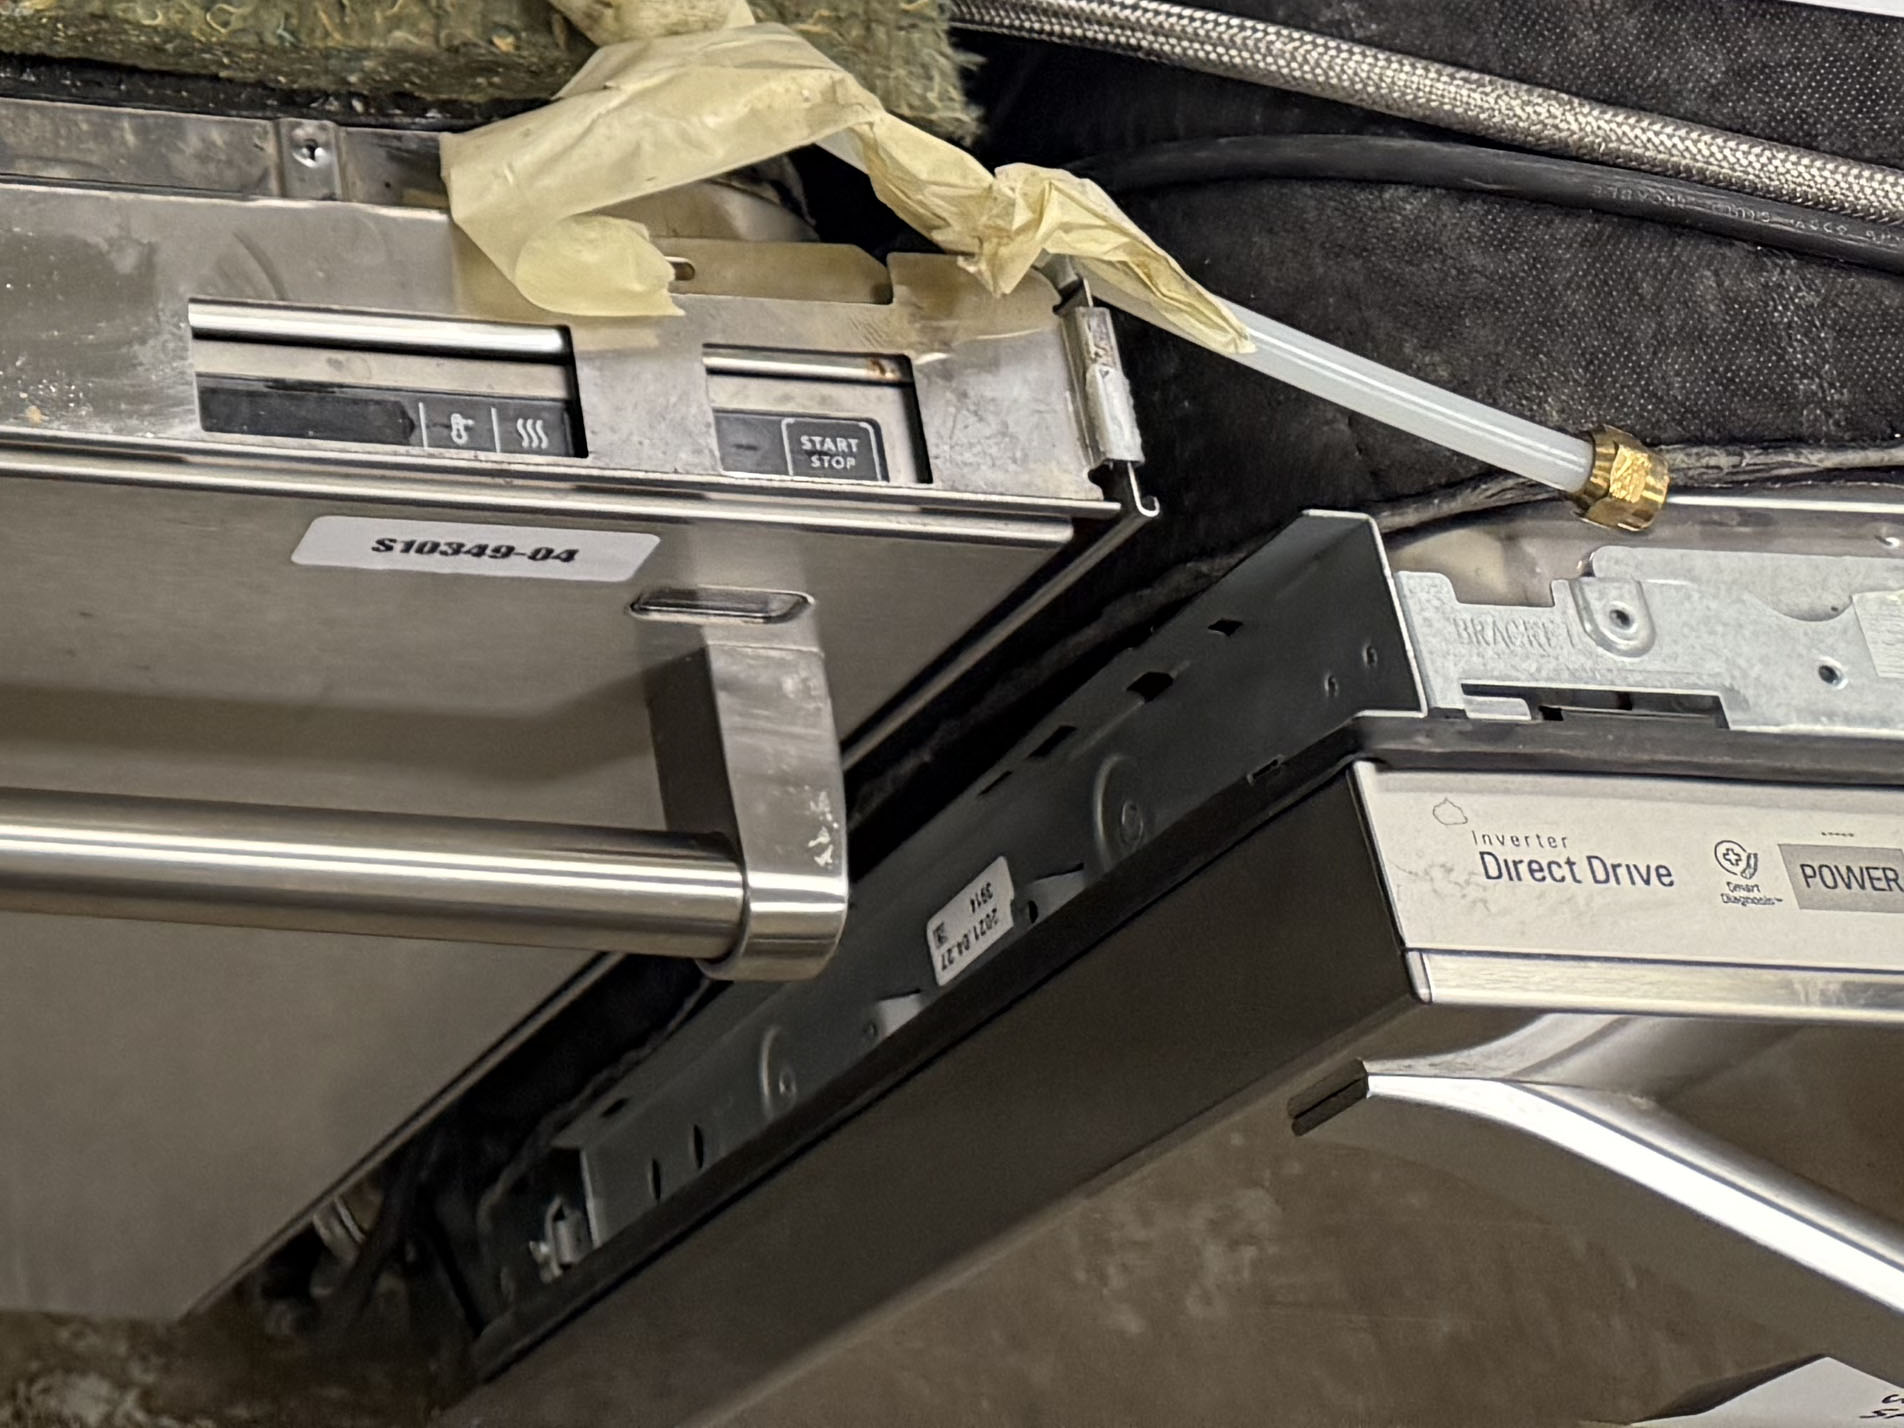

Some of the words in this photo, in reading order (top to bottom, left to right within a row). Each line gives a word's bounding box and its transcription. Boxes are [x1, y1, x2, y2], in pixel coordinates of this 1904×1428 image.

[800, 435, 859, 452] START
[810, 455, 856, 470] STOP
[371, 537, 580, 563] S10349-04
[1471, 830, 1569, 849] Inverter
[1479, 850, 1583, 883] Direct
[1585, 854, 1676, 888] Drive
[1800, 863, 1904, 892] POWER
